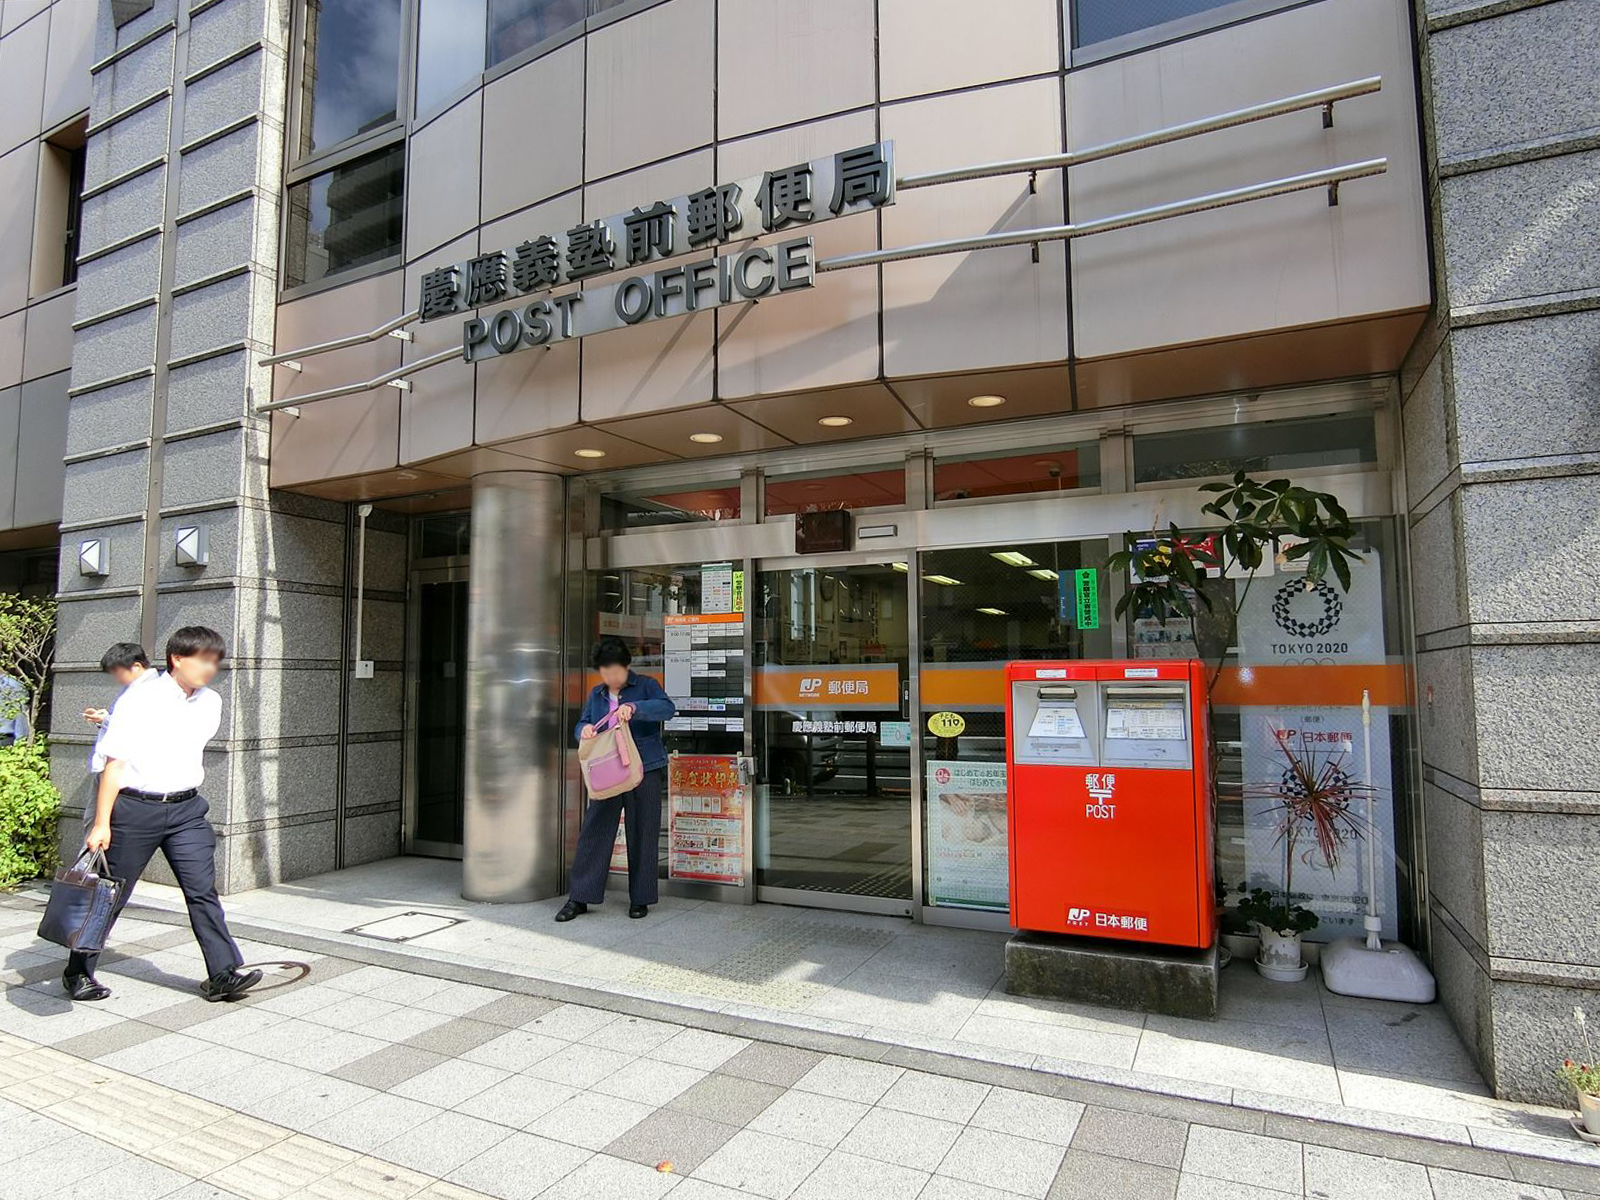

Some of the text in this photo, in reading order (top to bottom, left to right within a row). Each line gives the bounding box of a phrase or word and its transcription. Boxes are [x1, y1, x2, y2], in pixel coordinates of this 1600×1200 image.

[420, 142, 893, 323] 慶應義塾前郵便局
[462, 237, 812, 364] POST OFFICE
[1271, 643, 1348, 654] TOKYO 2020
[828, 680, 869, 695] 郵便局
[792, 720, 877, 734] 慶應義塾前郵便局
[1085, 773, 1116, 791] 郵便
[1086, 804, 1116, 819] POST
[1095, 913, 1148, 932] 日本郵便
